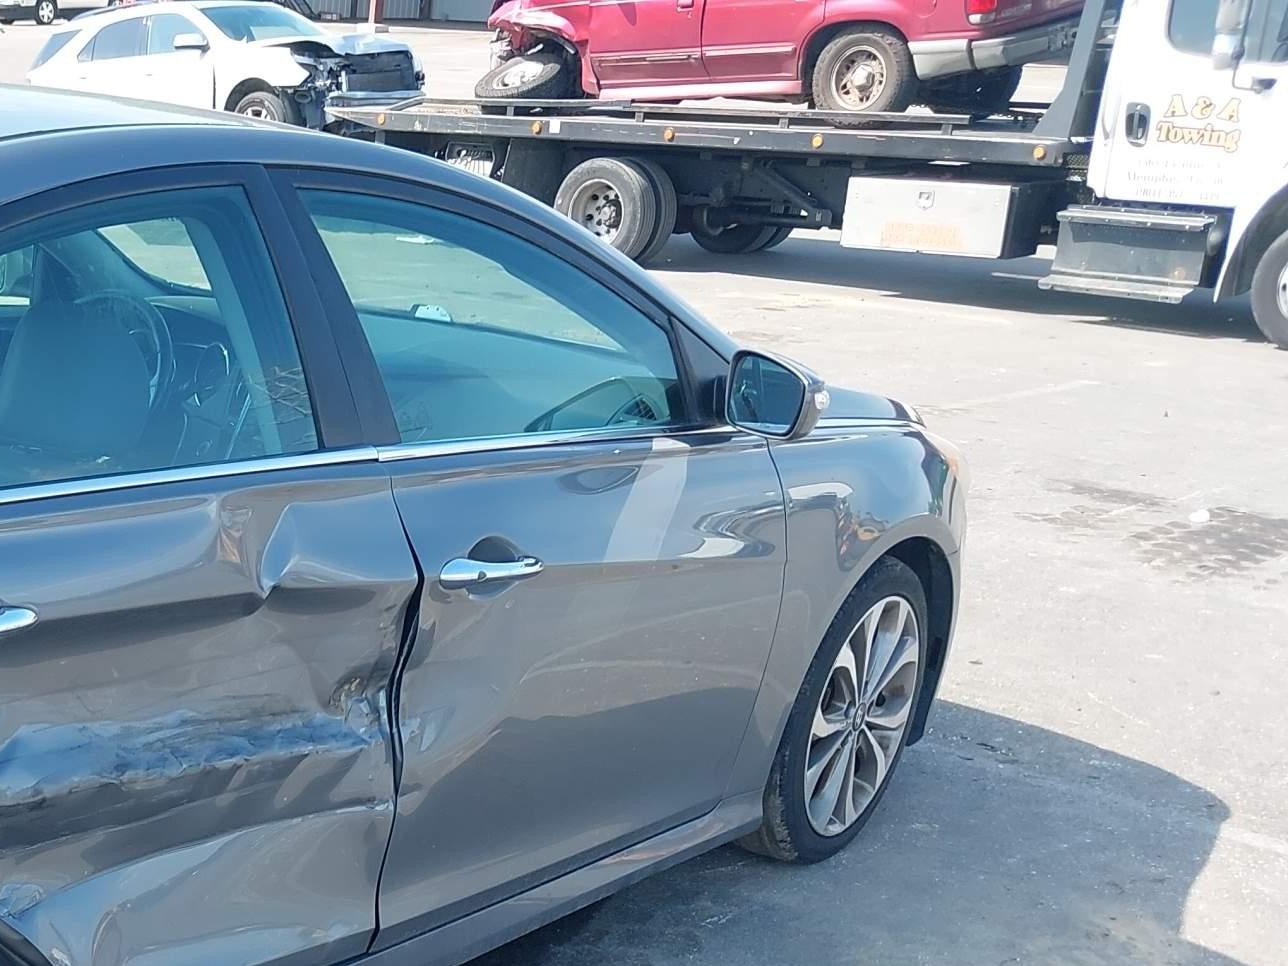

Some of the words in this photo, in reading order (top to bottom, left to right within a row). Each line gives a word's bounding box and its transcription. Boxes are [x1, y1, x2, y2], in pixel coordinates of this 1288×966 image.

[1163, 94, 1188, 118] A
[1191, 95, 1217, 120] &
[1216, 97, 1242, 123] A
[1155, 120, 1242, 153] Towing
